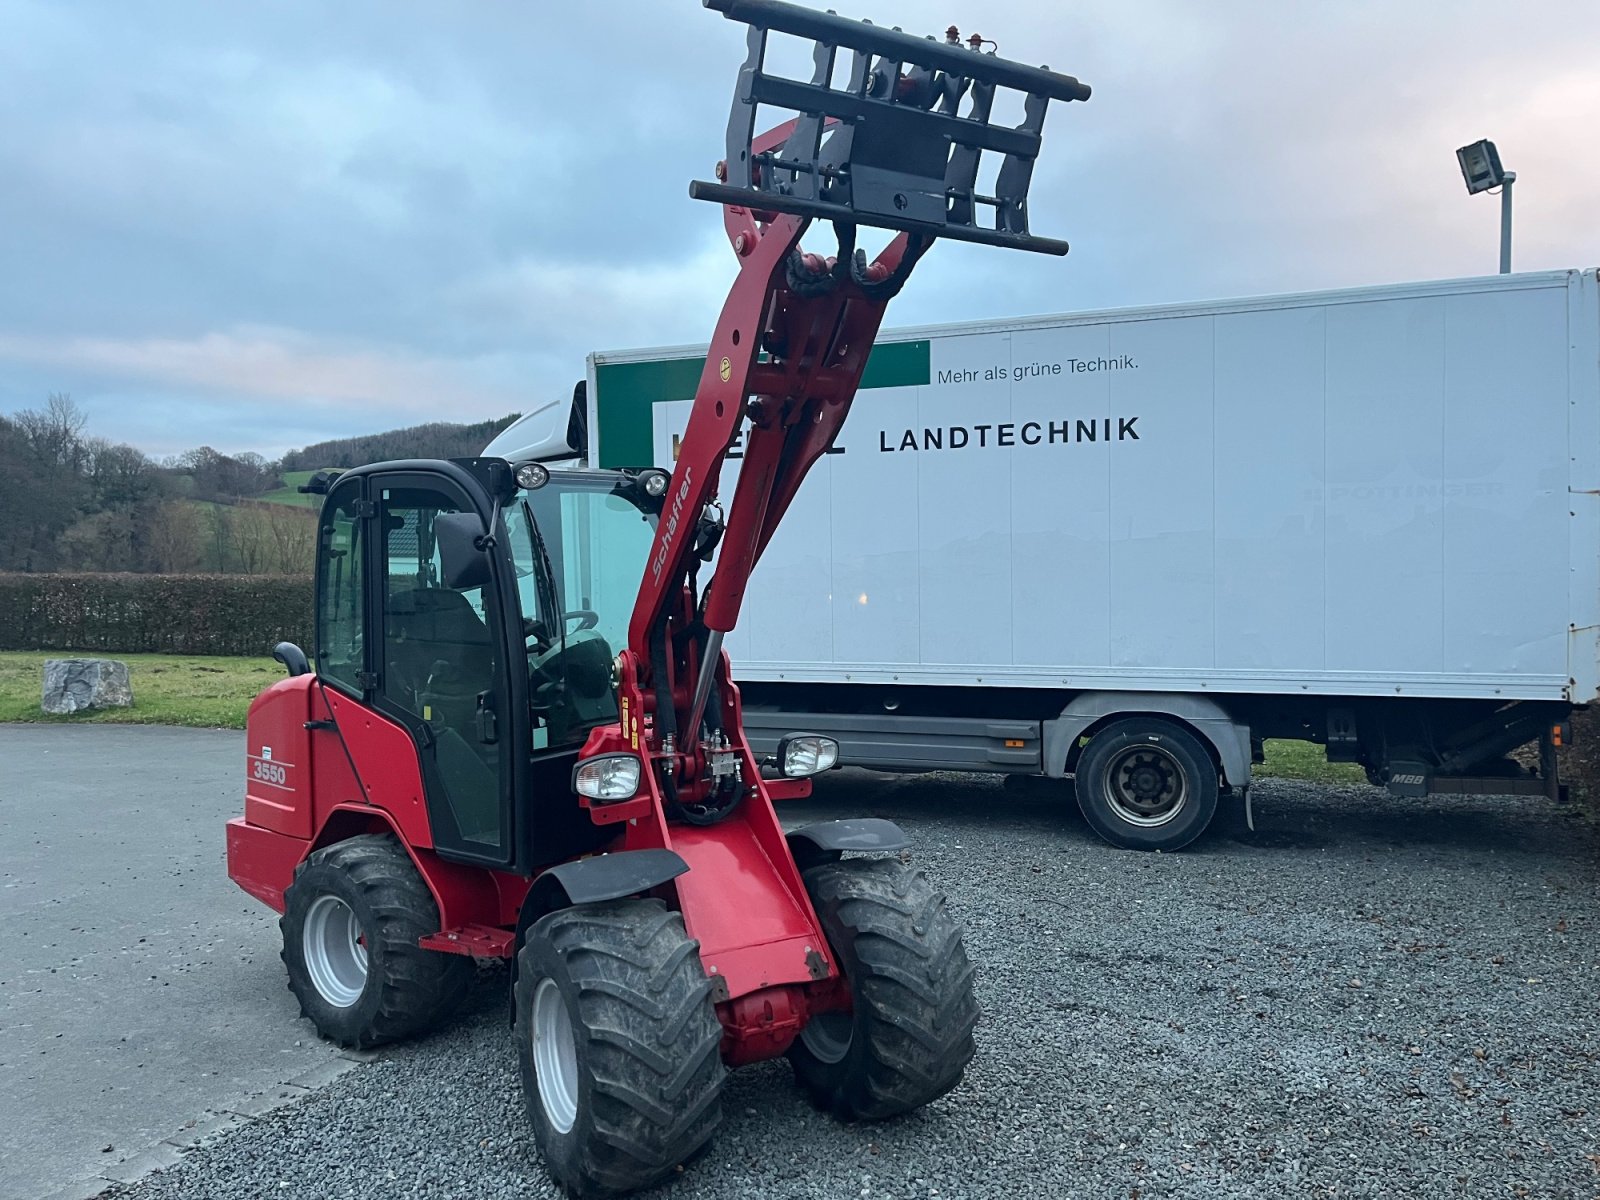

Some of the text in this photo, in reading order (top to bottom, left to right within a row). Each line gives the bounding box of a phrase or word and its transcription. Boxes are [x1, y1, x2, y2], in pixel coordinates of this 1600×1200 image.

[938, 354, 1139, 384] Mehr als grüne Technik.
[880, 417, 1140, 452] LANDTECHNIK
[653, 466, 692, 587] Schäffer
[254, 761, 286, 784] 3550
